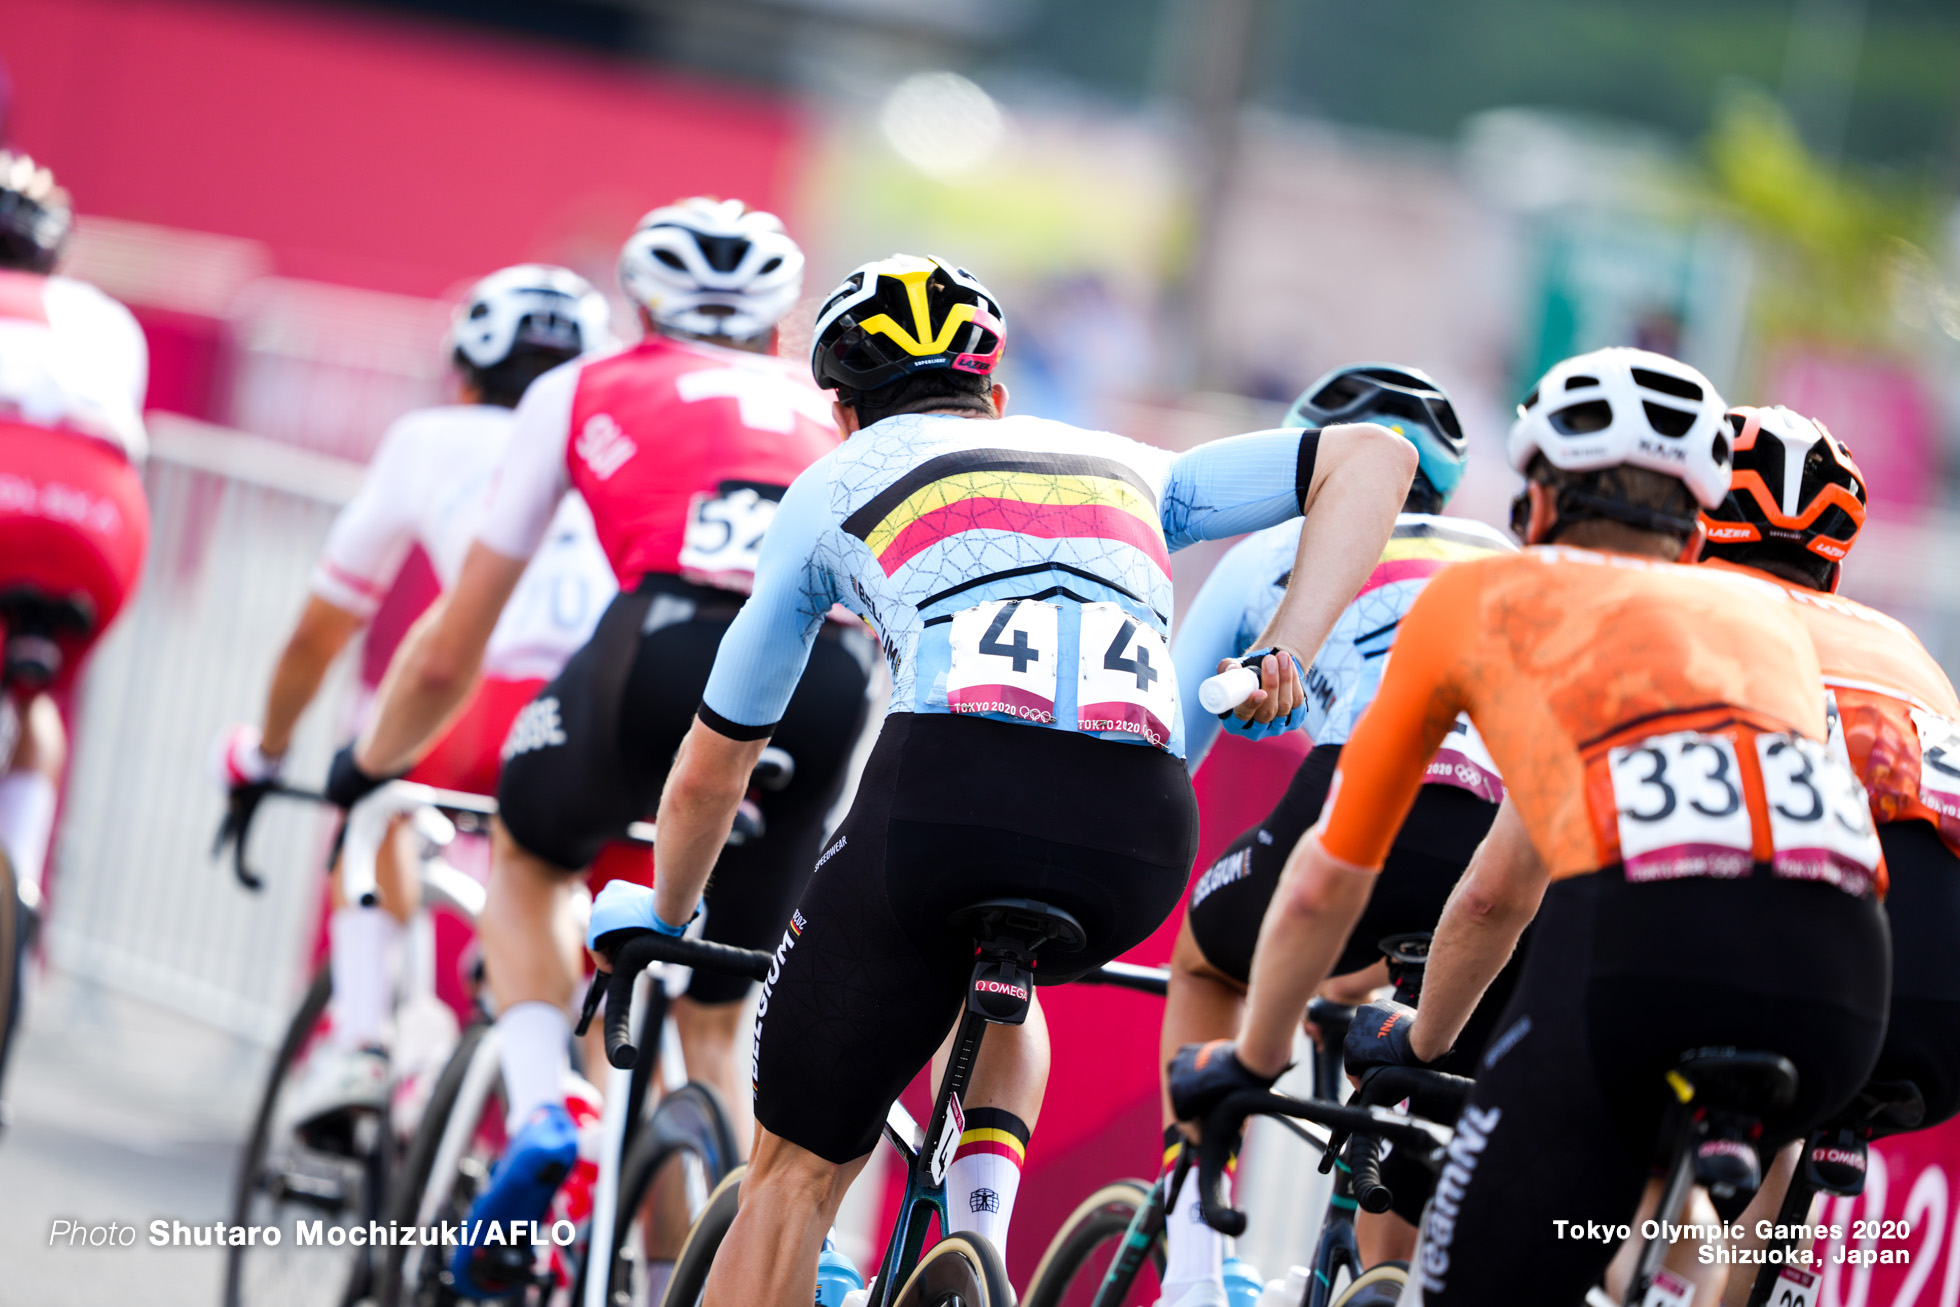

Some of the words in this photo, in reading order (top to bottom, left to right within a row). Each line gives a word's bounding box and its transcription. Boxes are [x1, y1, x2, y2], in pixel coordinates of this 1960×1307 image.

[958, 359, 991, 371] LAZER
[1707, 527, 1751, 539] LAZER
[1815, 543, 1846, 559] LAZER
[979, 601, 1039, 673] 4
[1103, 618, 1158, 692] 4
[954, 702, 989, 714] TOKYO
[991, 701, 1017, 715] 2020
[1115, 719, 1141, 734] 2020
[1426, 762, 1453, 776] 2020
[1617, 742, 1740, 822] 33
[814, 835, 848, 873] SPEEDWEAR
[989, 981, 1029, 1002] OMEGA
[752, 929, 796, 1083] BELGIUM
